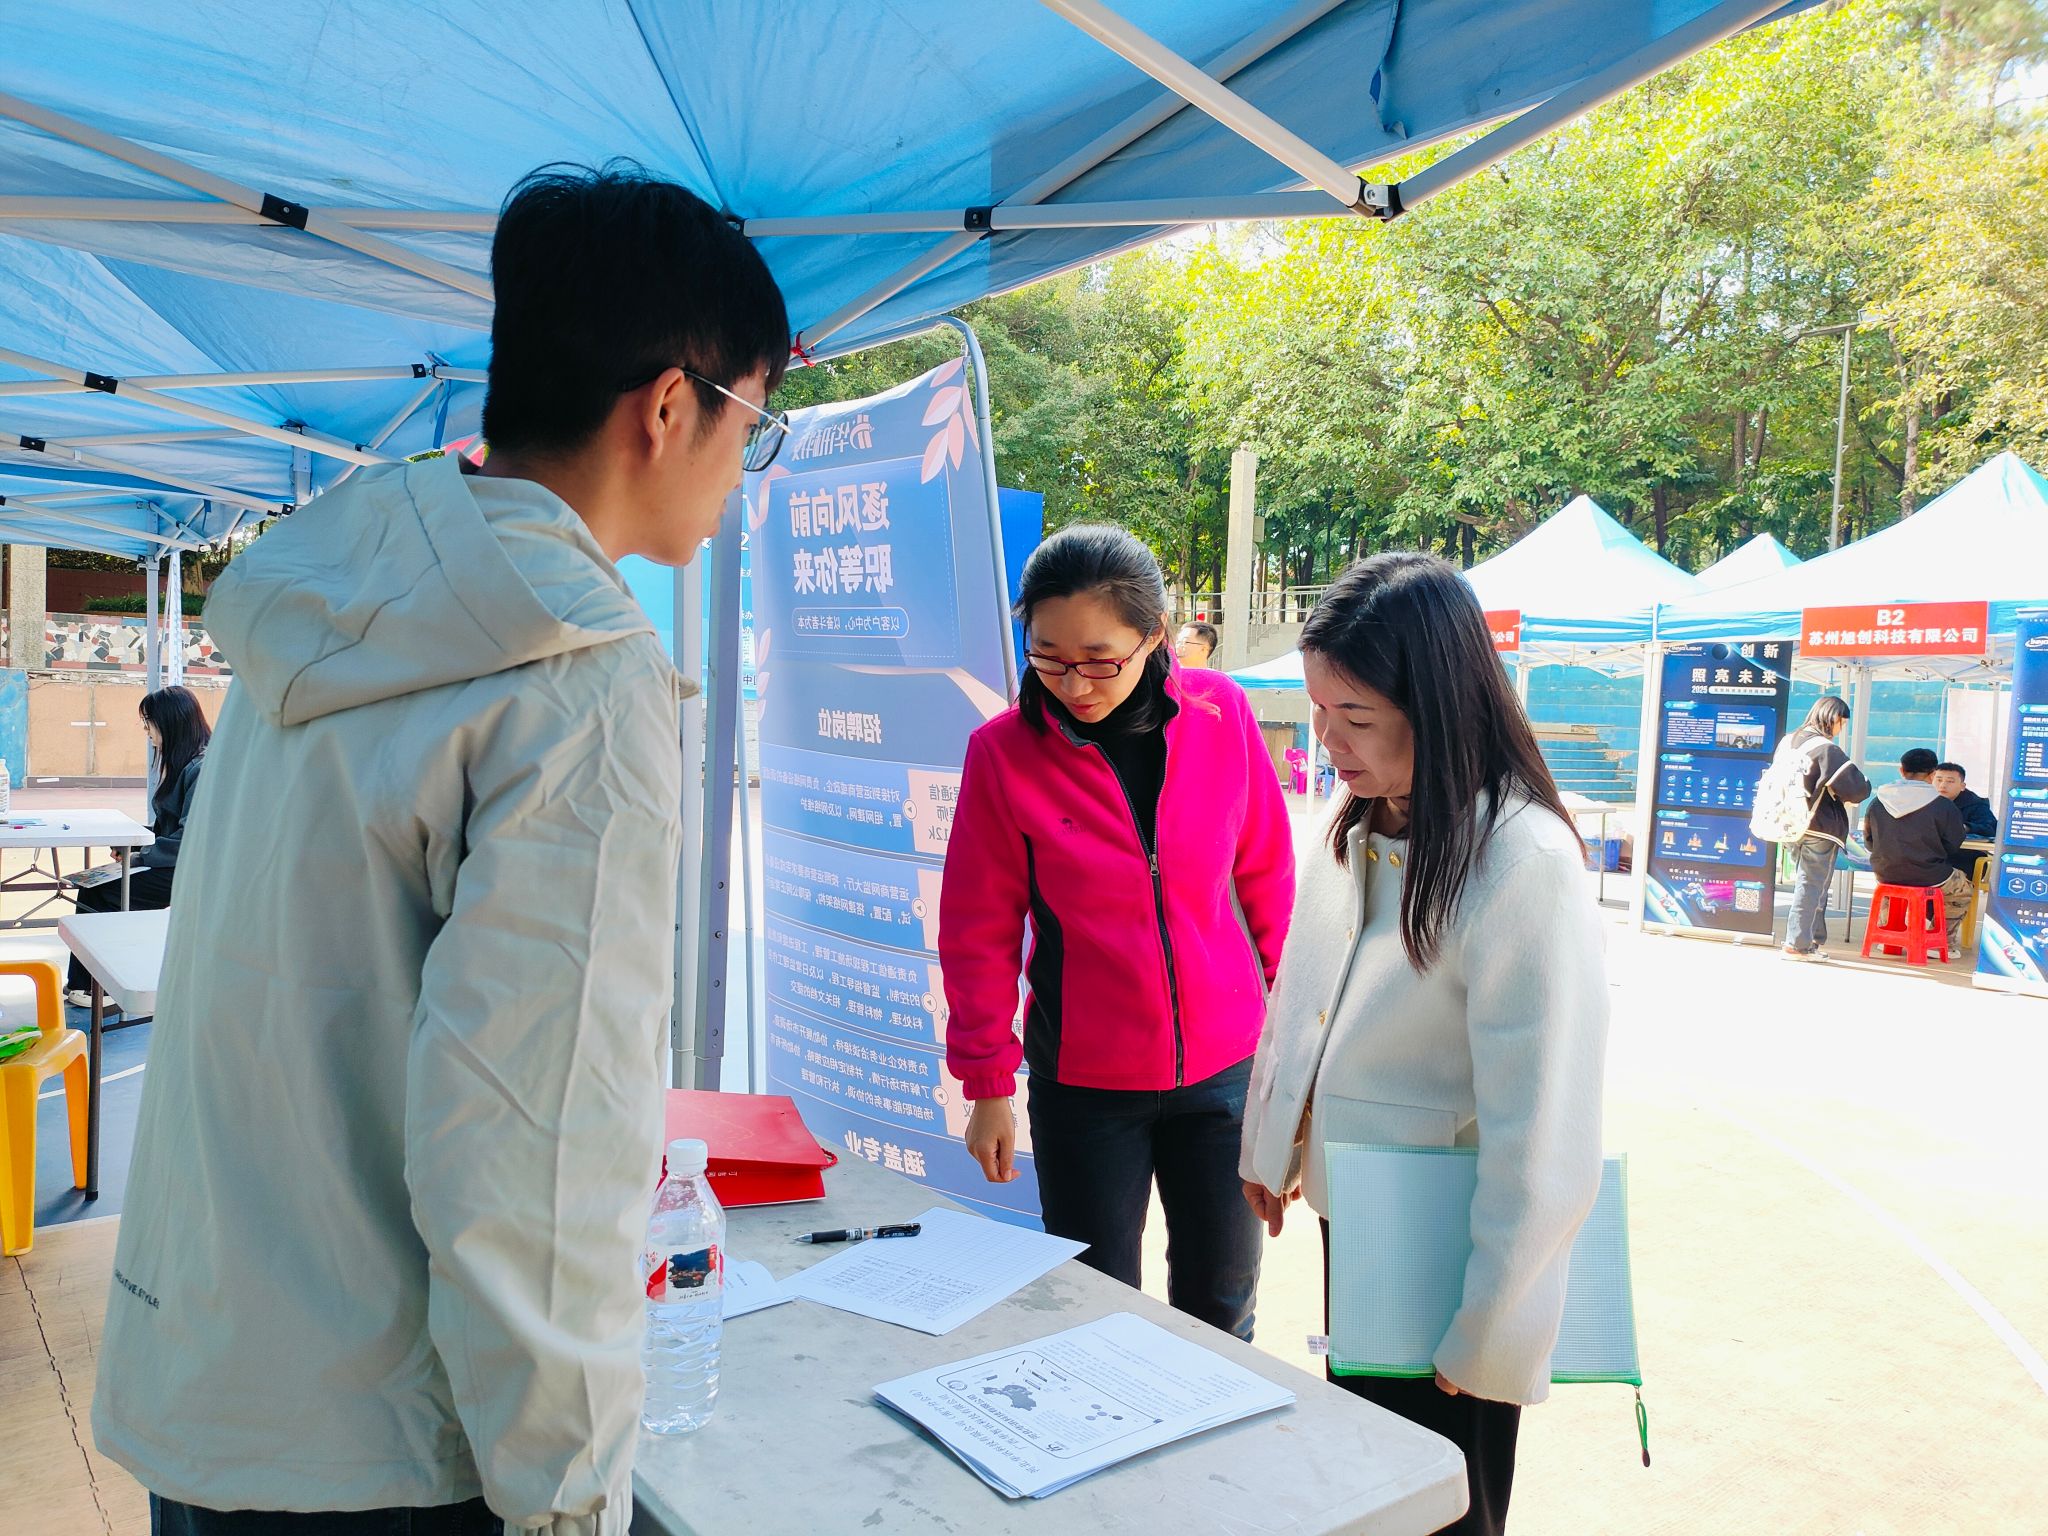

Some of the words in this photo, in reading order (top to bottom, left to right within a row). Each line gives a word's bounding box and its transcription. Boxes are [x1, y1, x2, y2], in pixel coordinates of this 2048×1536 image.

[1876, 609, 1905, 626] B2
[1491, 631, 1515, 643] 公司
[1808, 627, 1979, 646] 苏州旭创科技有限公司
[1741, 643, 1779, 659] 创新
[1692, 668, 1777, 684] 照亮未来
[1692, 685, 1708, 694] 2025
